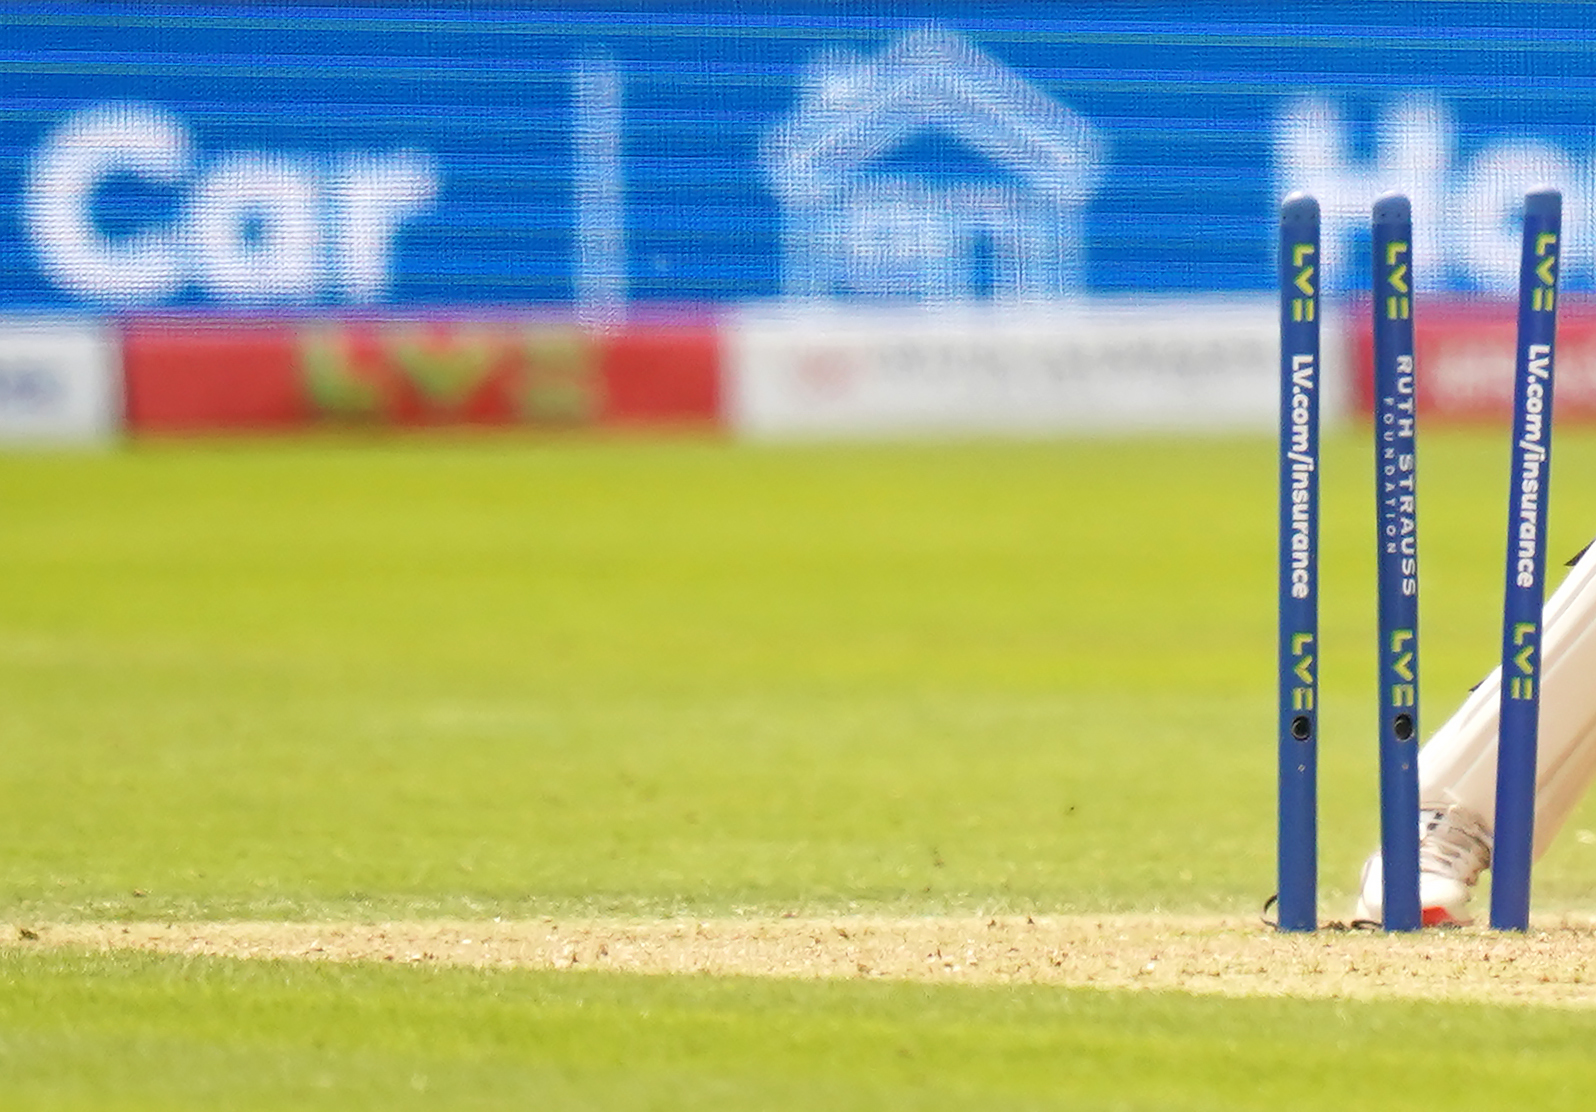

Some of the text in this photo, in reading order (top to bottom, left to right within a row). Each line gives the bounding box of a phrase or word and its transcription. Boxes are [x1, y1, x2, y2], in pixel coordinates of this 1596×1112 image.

[22, 98, 442, 307] Car
[1287, 353, 1316, 599] LV.com/insurance
[1383, 397, 1397, 554] FOUNDATION
[1396, 354, 1417, 596] RUTH STRAUSS
[1515, 342, 1551, 590] LV.com/insurance
